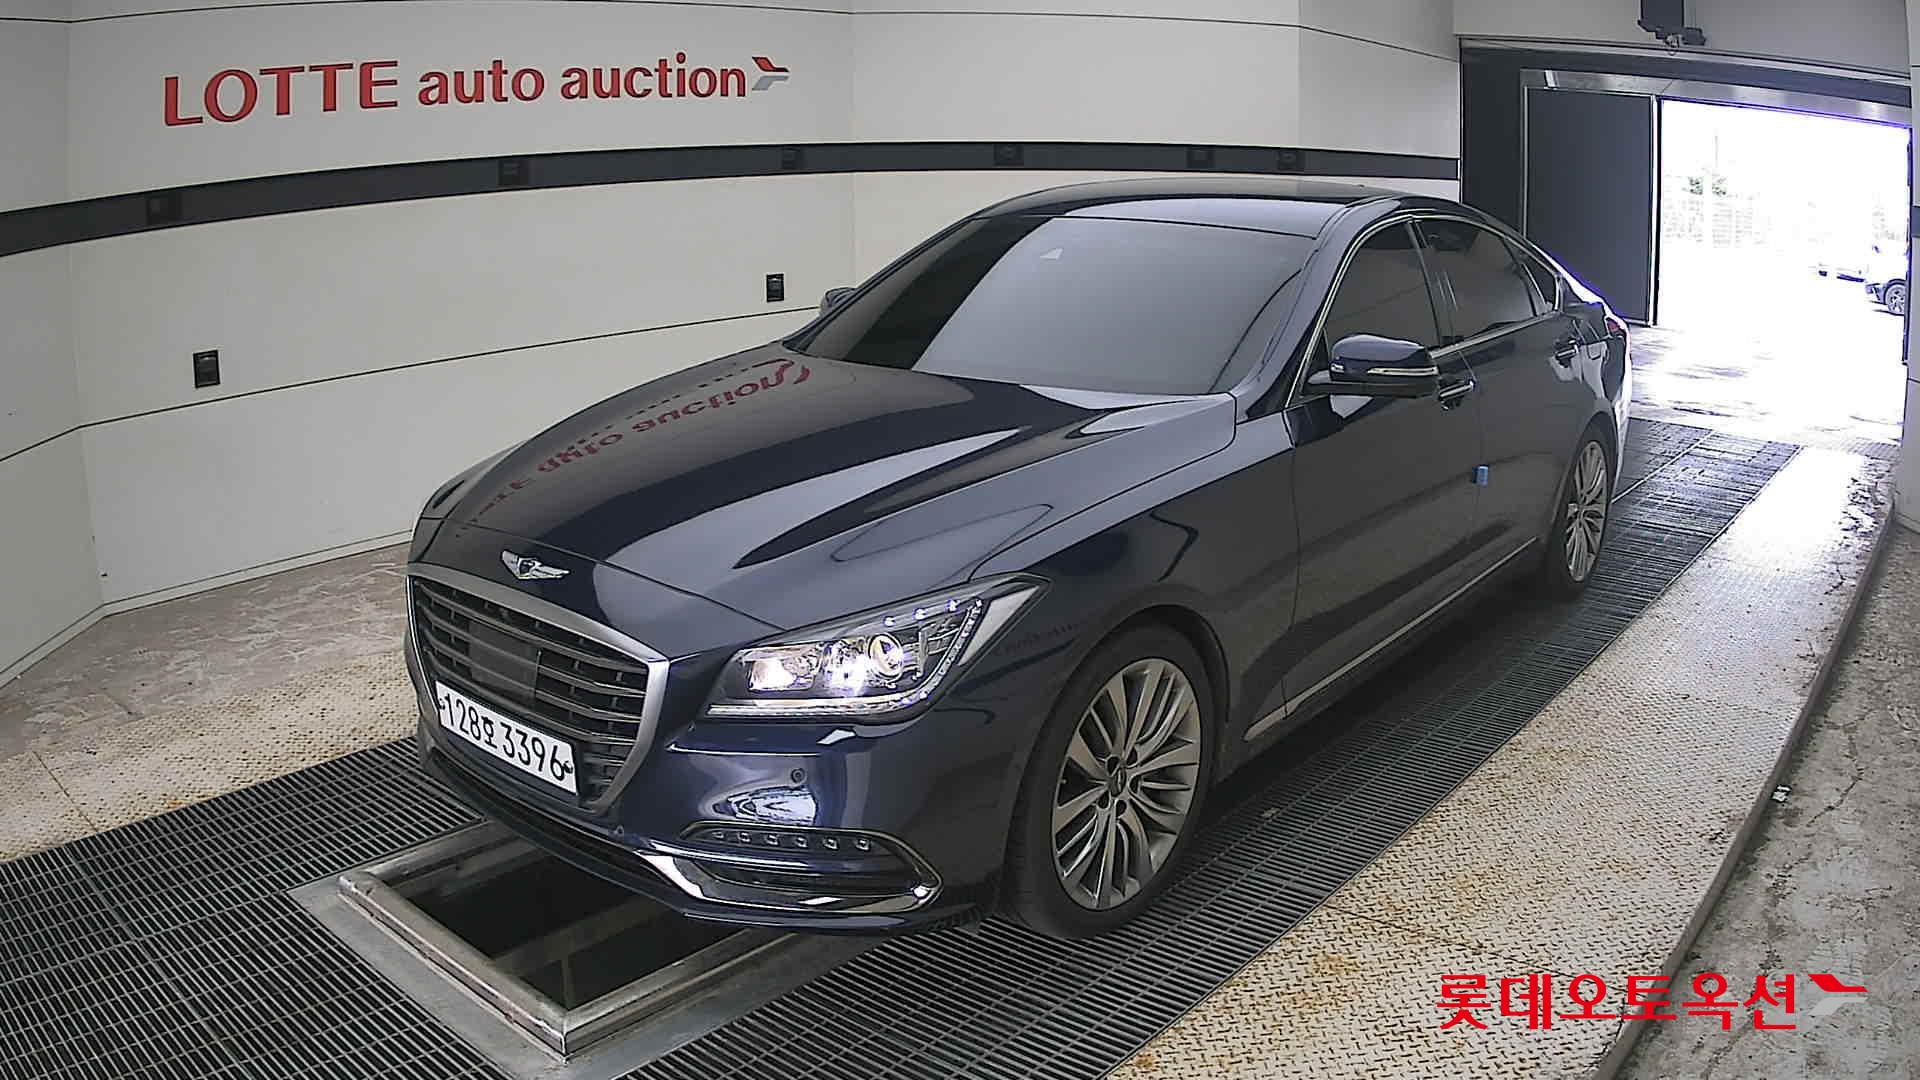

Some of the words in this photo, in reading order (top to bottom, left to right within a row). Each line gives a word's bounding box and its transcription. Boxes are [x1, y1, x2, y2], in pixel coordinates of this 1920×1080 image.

[163, 60, 400, 126] LOTTE
[417, 60, 545, 106] auto
[560, 52, 748, 99] auction
